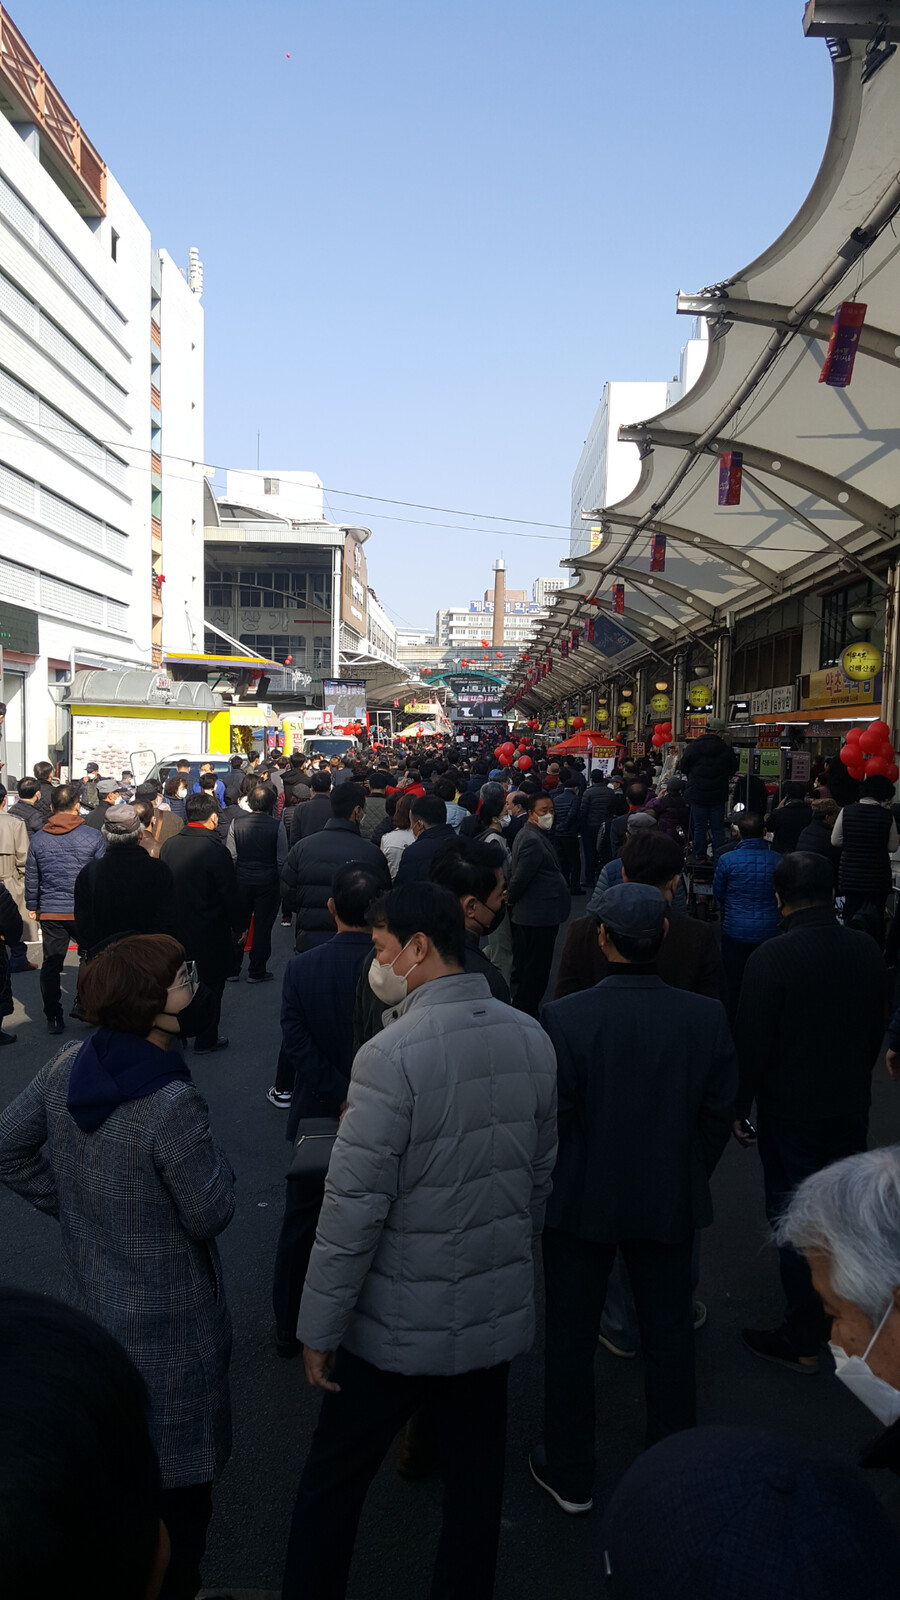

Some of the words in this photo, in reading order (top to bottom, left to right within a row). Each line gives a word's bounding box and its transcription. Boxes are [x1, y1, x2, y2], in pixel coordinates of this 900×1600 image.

[470, 601, 540, 613] 계명대학교
[849, 664, 876, 673] 건해산물
[825, 670, 842, 696] 약초
[325, 714, 331, 722] 2
